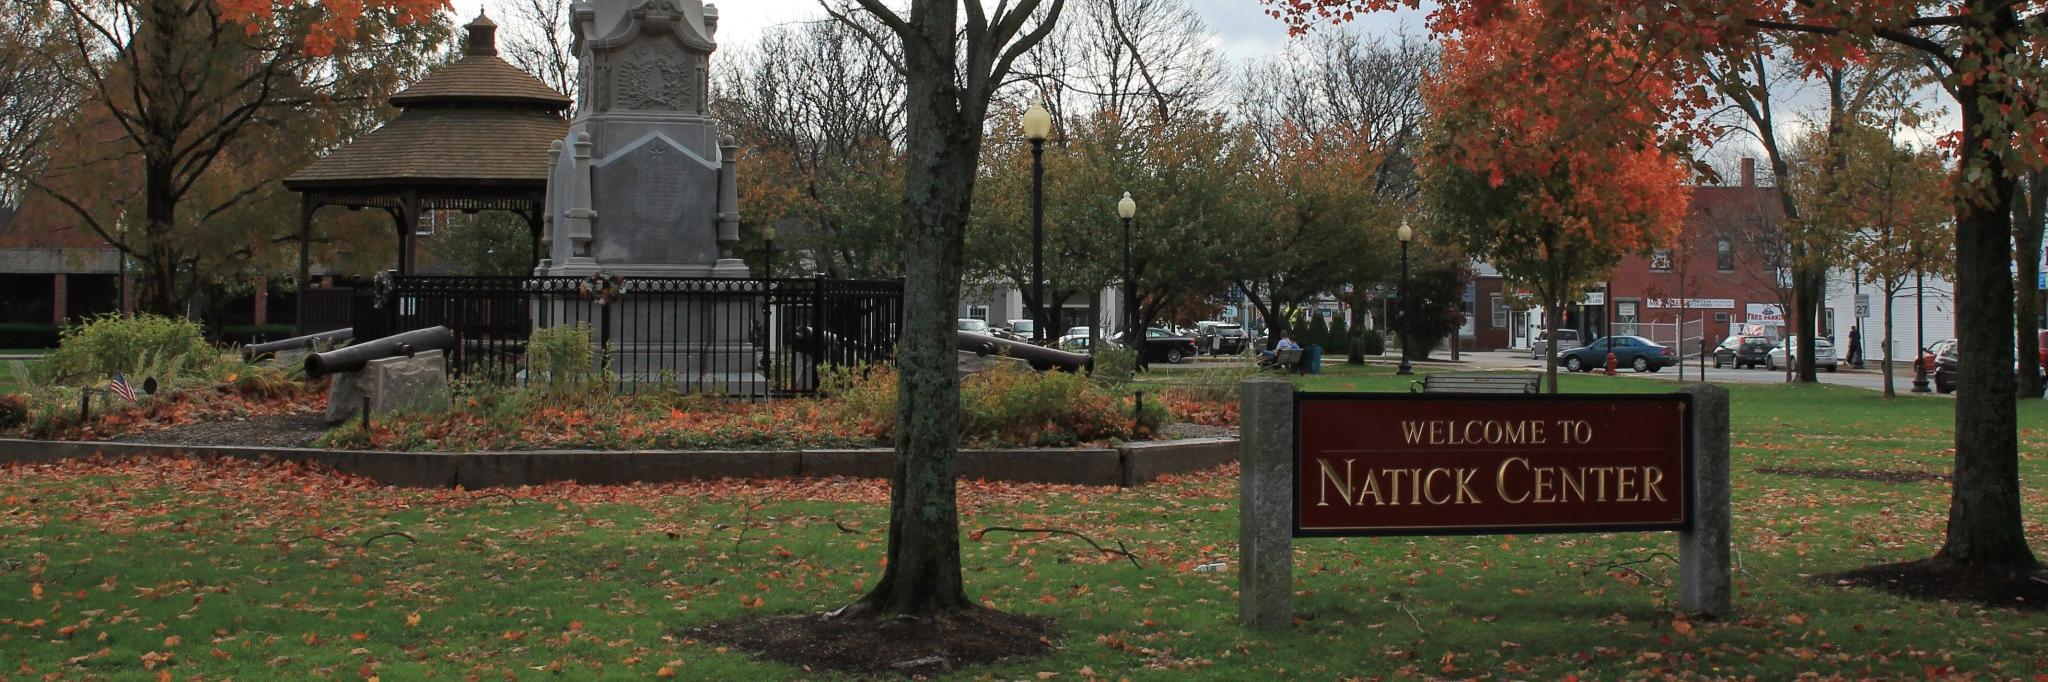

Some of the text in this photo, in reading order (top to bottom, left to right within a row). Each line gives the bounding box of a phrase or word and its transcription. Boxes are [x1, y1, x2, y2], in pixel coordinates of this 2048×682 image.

[1856, 305, 1868, 315] 27
[1401, 419, 1592, 444] WELCOME TO
[1315, 456, 1667, 506] NATICK CENTER
